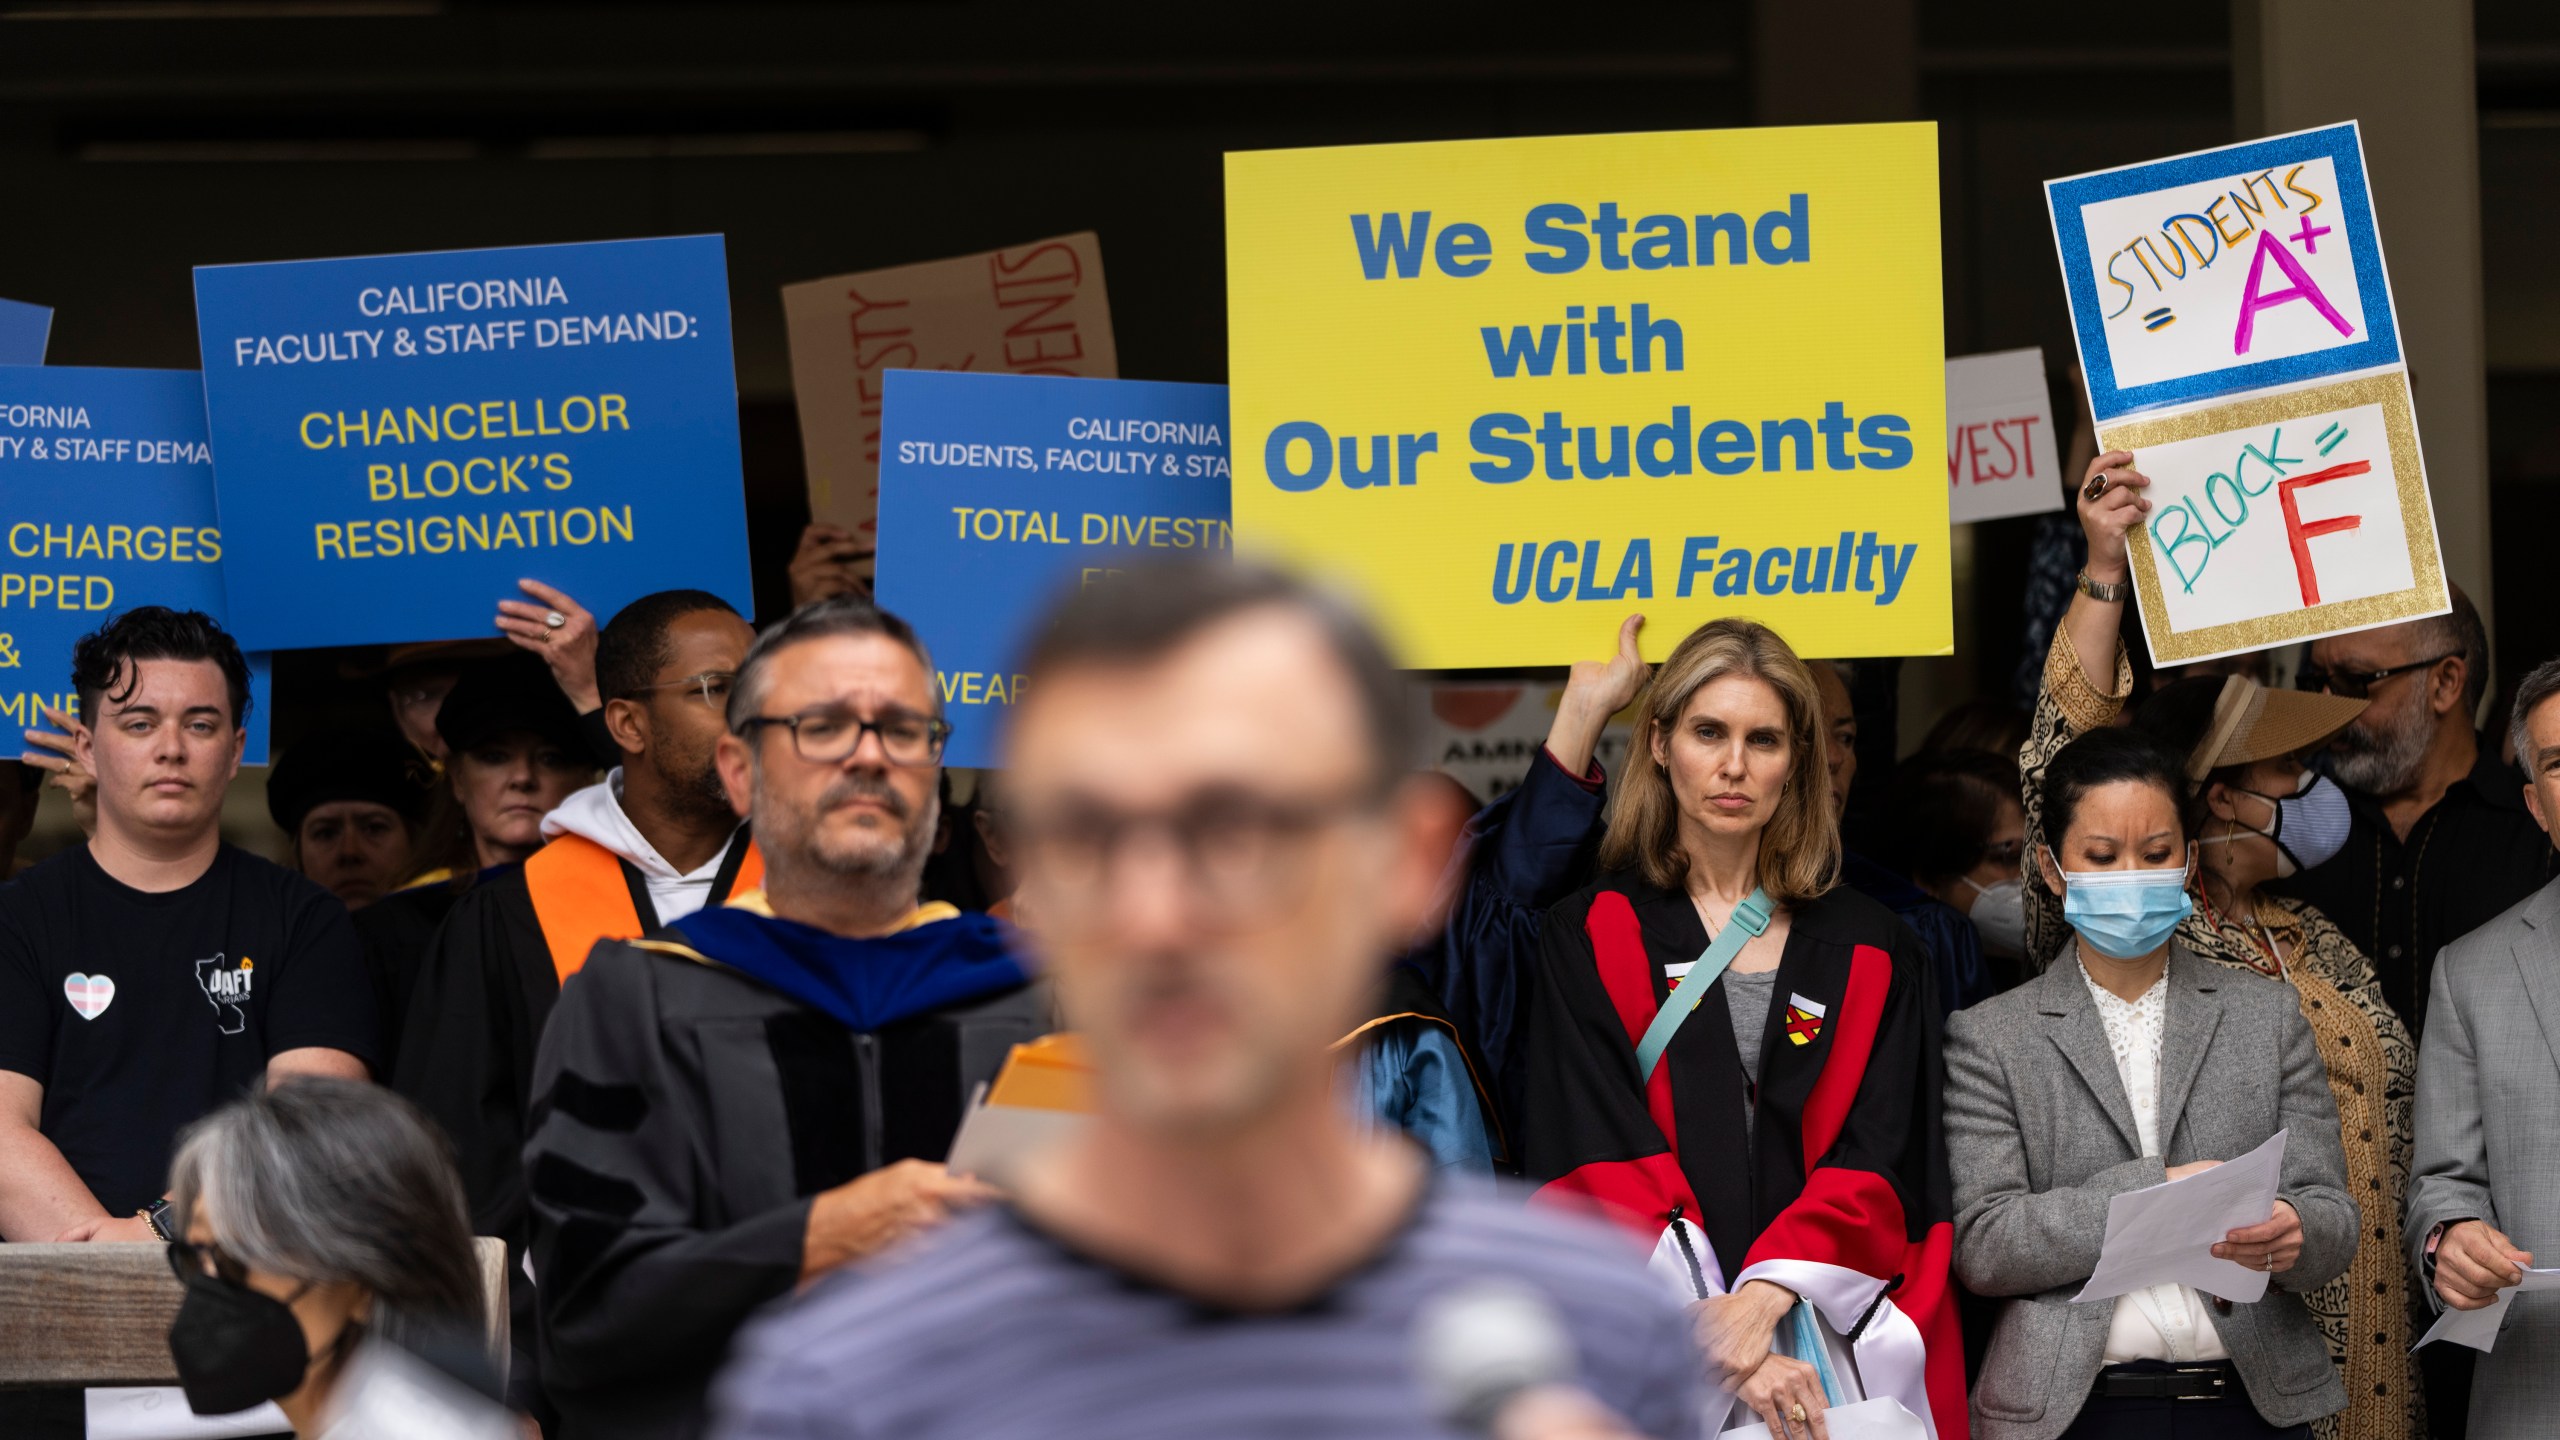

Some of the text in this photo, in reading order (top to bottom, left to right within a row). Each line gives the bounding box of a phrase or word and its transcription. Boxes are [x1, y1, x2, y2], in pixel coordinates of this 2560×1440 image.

[1349, 192, 1811, 281] We Stand
[2107, 165, 2323, 320] STUDENTS
[358, 276, 570, 318] CALIFORNIA
[235, 309, 700, 367] FACULTY & STAFF DEMAND:
[1479, 302, 1685, 379] with
[30, 436, 49, 461] &
[54, 438, 131, 463] STAFF
[300, 393, 632, 450] CHANCELLOR
[1067, 417, 1223, 447] CALIFORNIA
[1264, 400, 1914, 493] Our Students
[368, 452, 574, 502] BLOCK’S
[898, 440, 1039, 473] STUDENTS,
[1045, 447, 1157, 475] FACULTY
[1161, 455, 1180, 476] &
[315, 505, 636, 561] RESIGNATION
[952, 506, 1071, 545] TOTAL
[2149, 427, 2304, 594] BLOCK
[2278, 459, 2372, 608] F
[8, 521, 223, 564] CHARGES
[1491, 530, 1919, 606] UCLA Faculty
